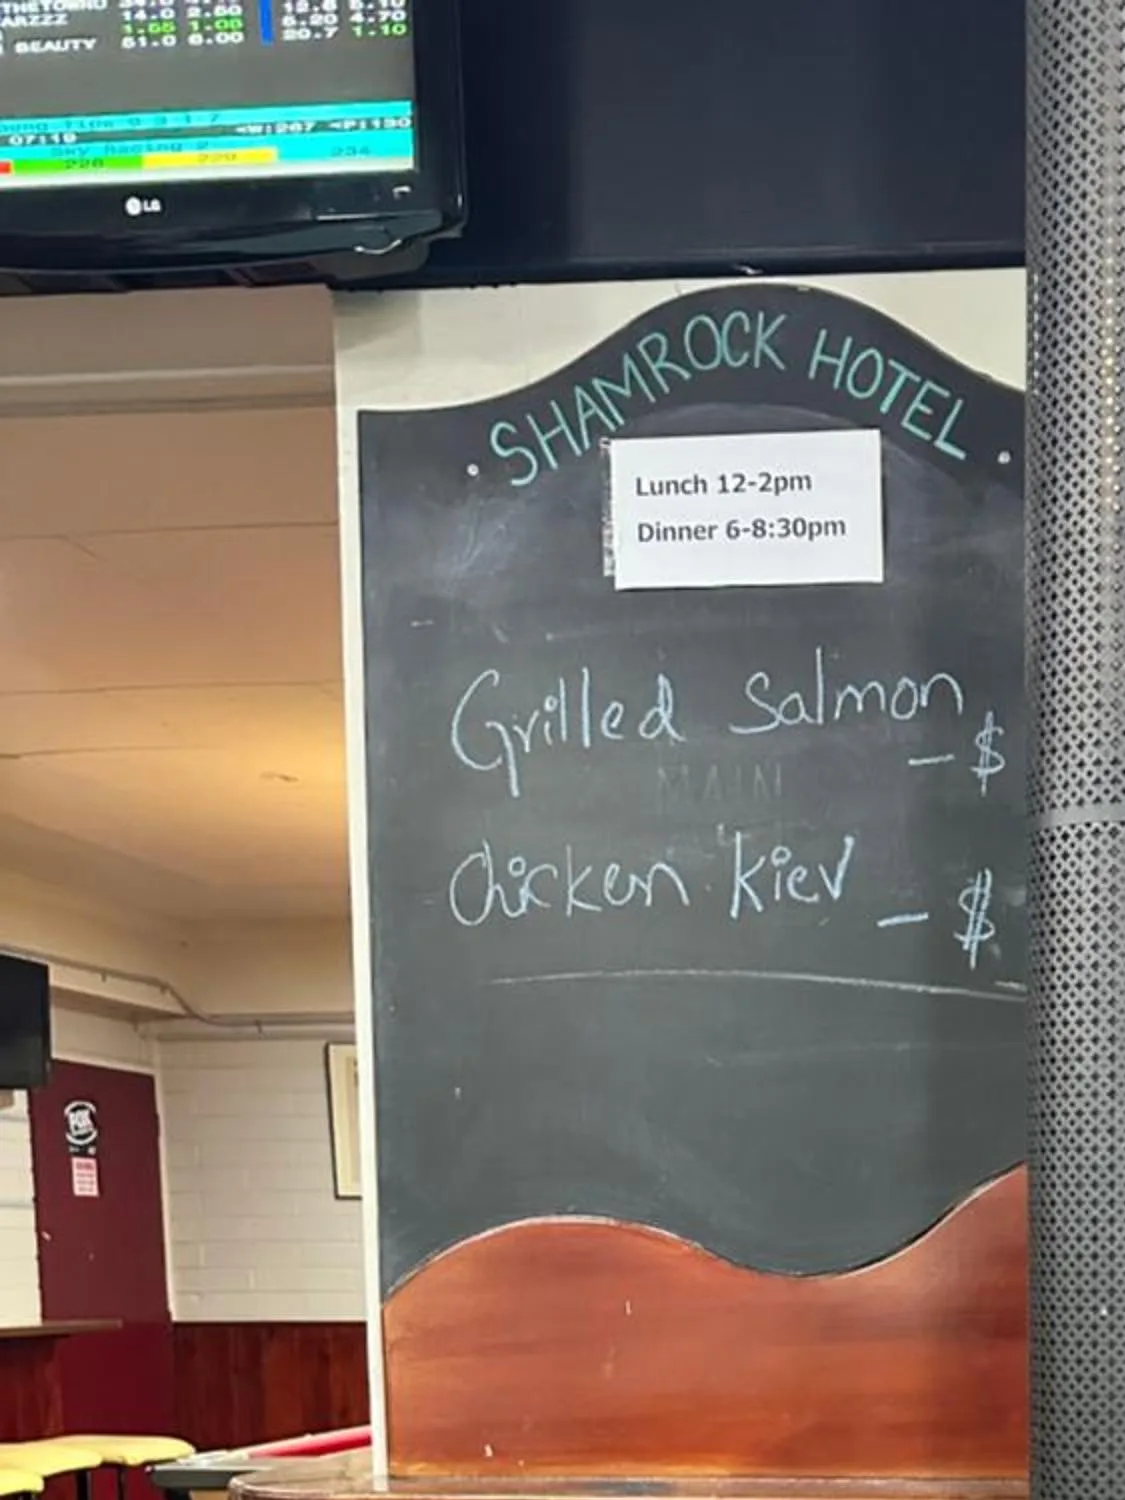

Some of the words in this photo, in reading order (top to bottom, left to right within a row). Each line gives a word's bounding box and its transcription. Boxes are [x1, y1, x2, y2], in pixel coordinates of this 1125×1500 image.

[489, 309, 787, 487] SHAMROCK
[807, 327, 967, 461] HOTEL
[636, 474, 708, 497] Lunch
[717, 471, 812, 497] 12-2pm
[637, 518, 718, 543] Dinner
[725, 516, 846, 542] 6-8:30pm
[450, 666, 686, 798] Grilled
[730, 647, 964, 735] Salmon
[969, 710, 1005, 796] $
[953, 867, 997, 970] $
